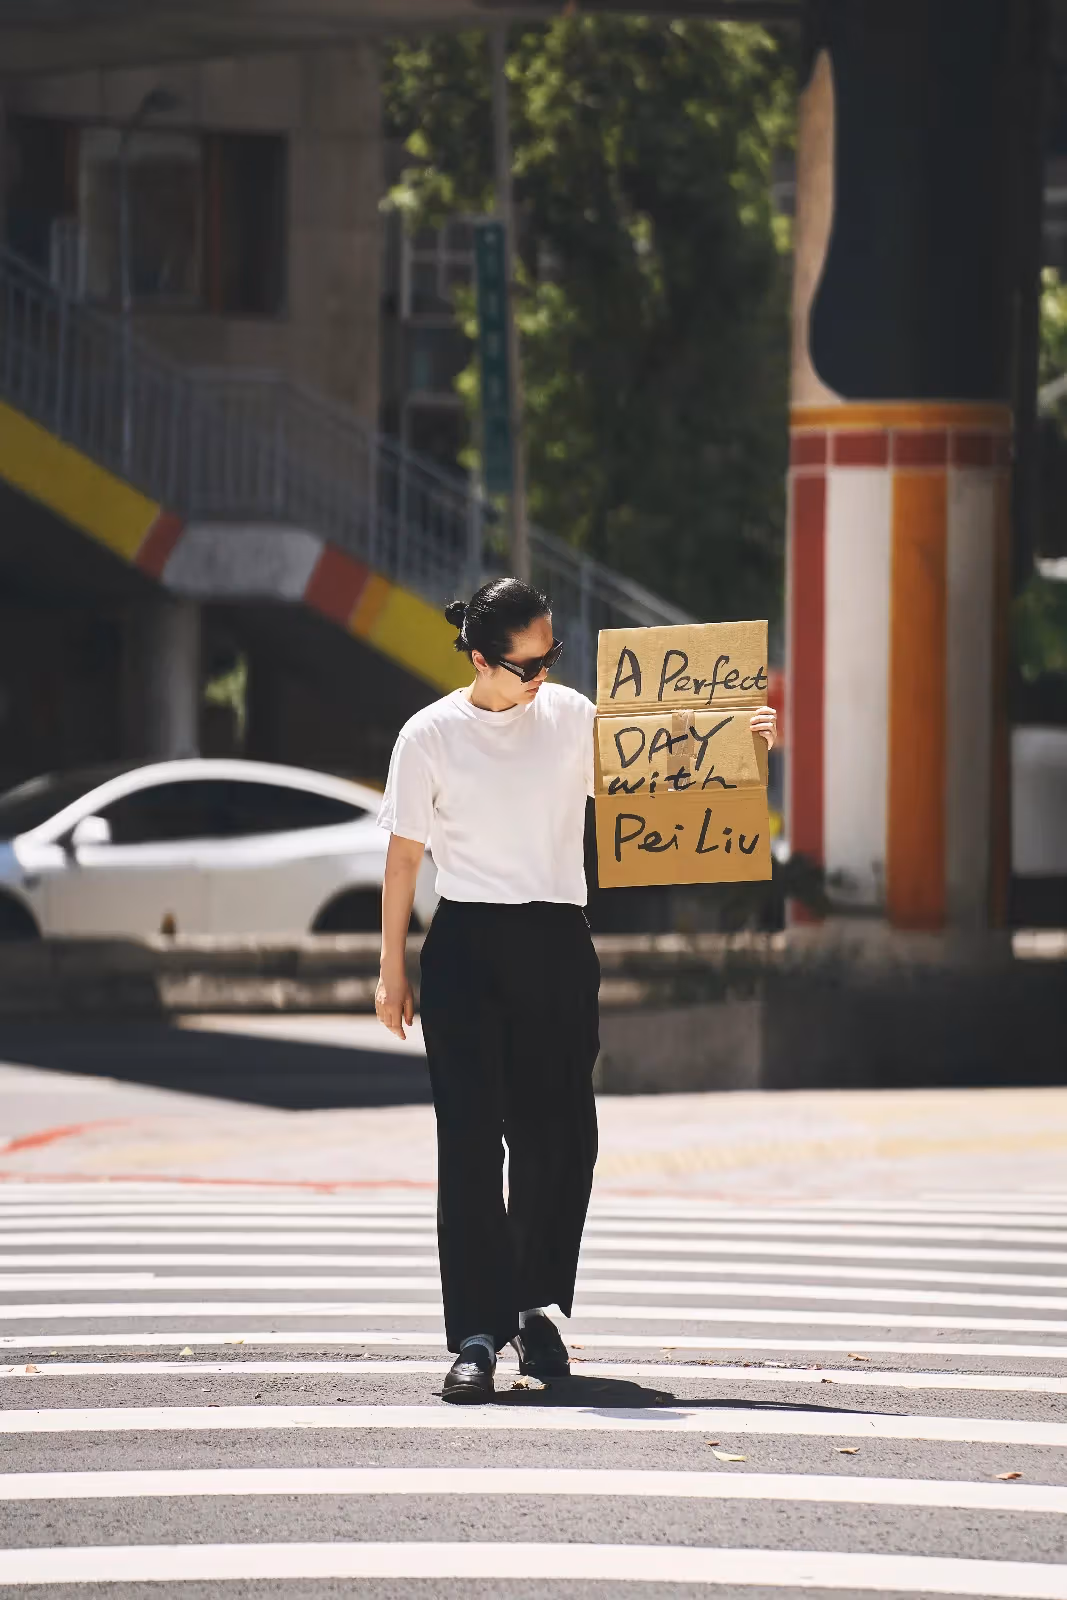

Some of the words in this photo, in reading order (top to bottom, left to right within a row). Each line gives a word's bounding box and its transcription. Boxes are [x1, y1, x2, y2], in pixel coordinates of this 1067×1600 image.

[610, 646, 642, 699] A
[658, 650, 768, 705] Perfect
[614, 716, 734, 771] DAY
[608, 765, 737, 797] with
[614, 813, 684, 862] Pei
[695, 808, 760, 854] Liu
